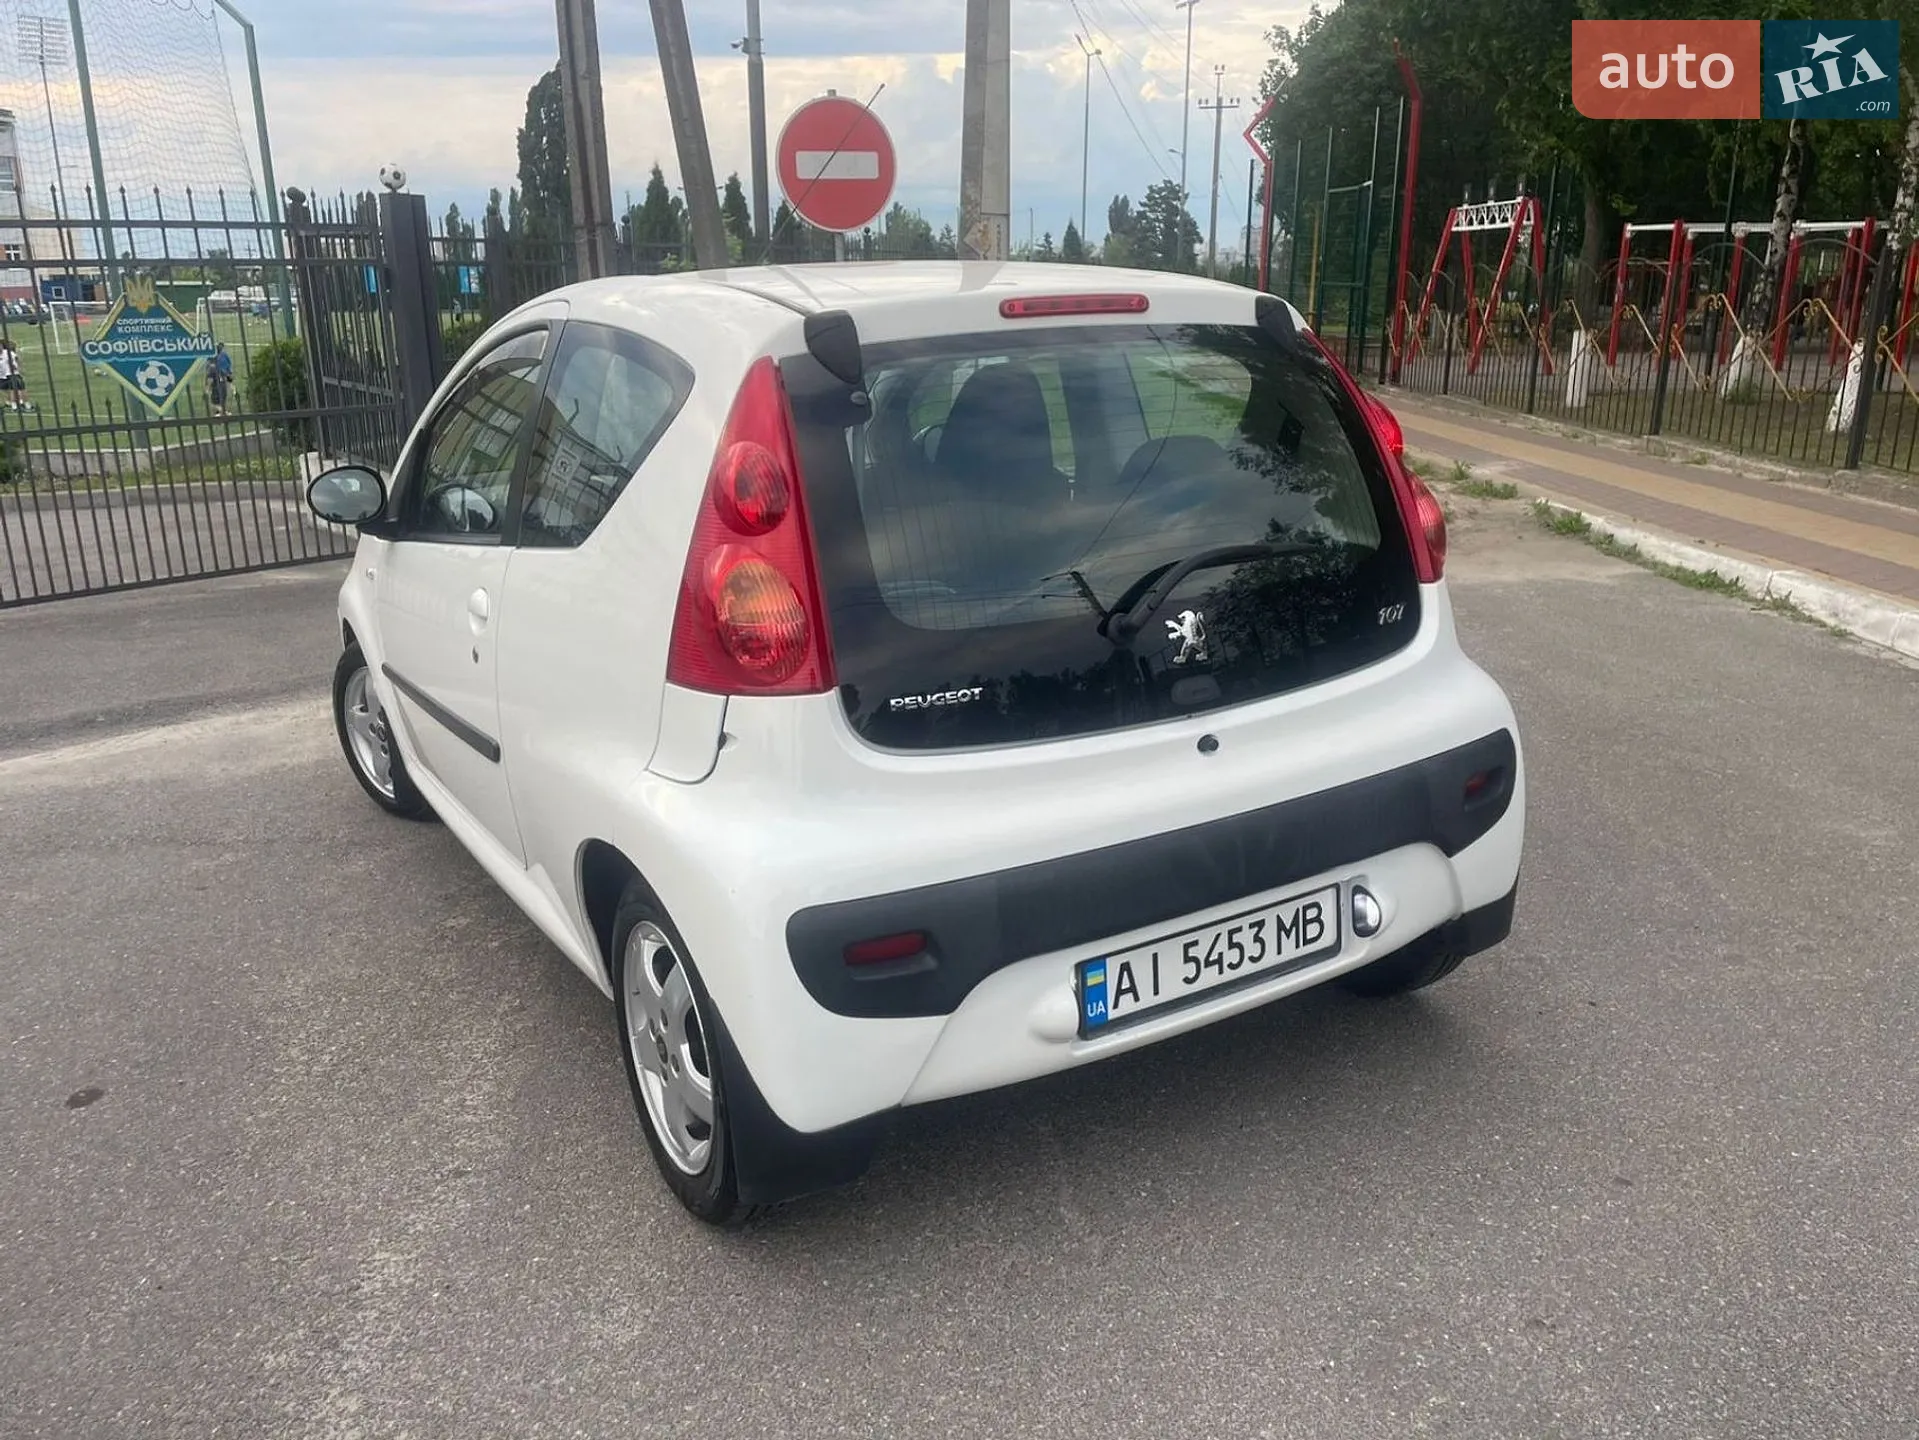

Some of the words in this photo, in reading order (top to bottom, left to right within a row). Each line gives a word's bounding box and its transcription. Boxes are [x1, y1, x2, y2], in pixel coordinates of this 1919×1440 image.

[117, 324, 174, 334] КОМПЛЕКС
[85, 333, 213, 355] СОФІЇВСЬКИЙ
[889, 687, 984, 712] PEUGEOT
[1182, 919, 1267, 985] 5453
[1276, 901, 1325, 955] MB
[1087, 1000, 1107, 1017] UA
